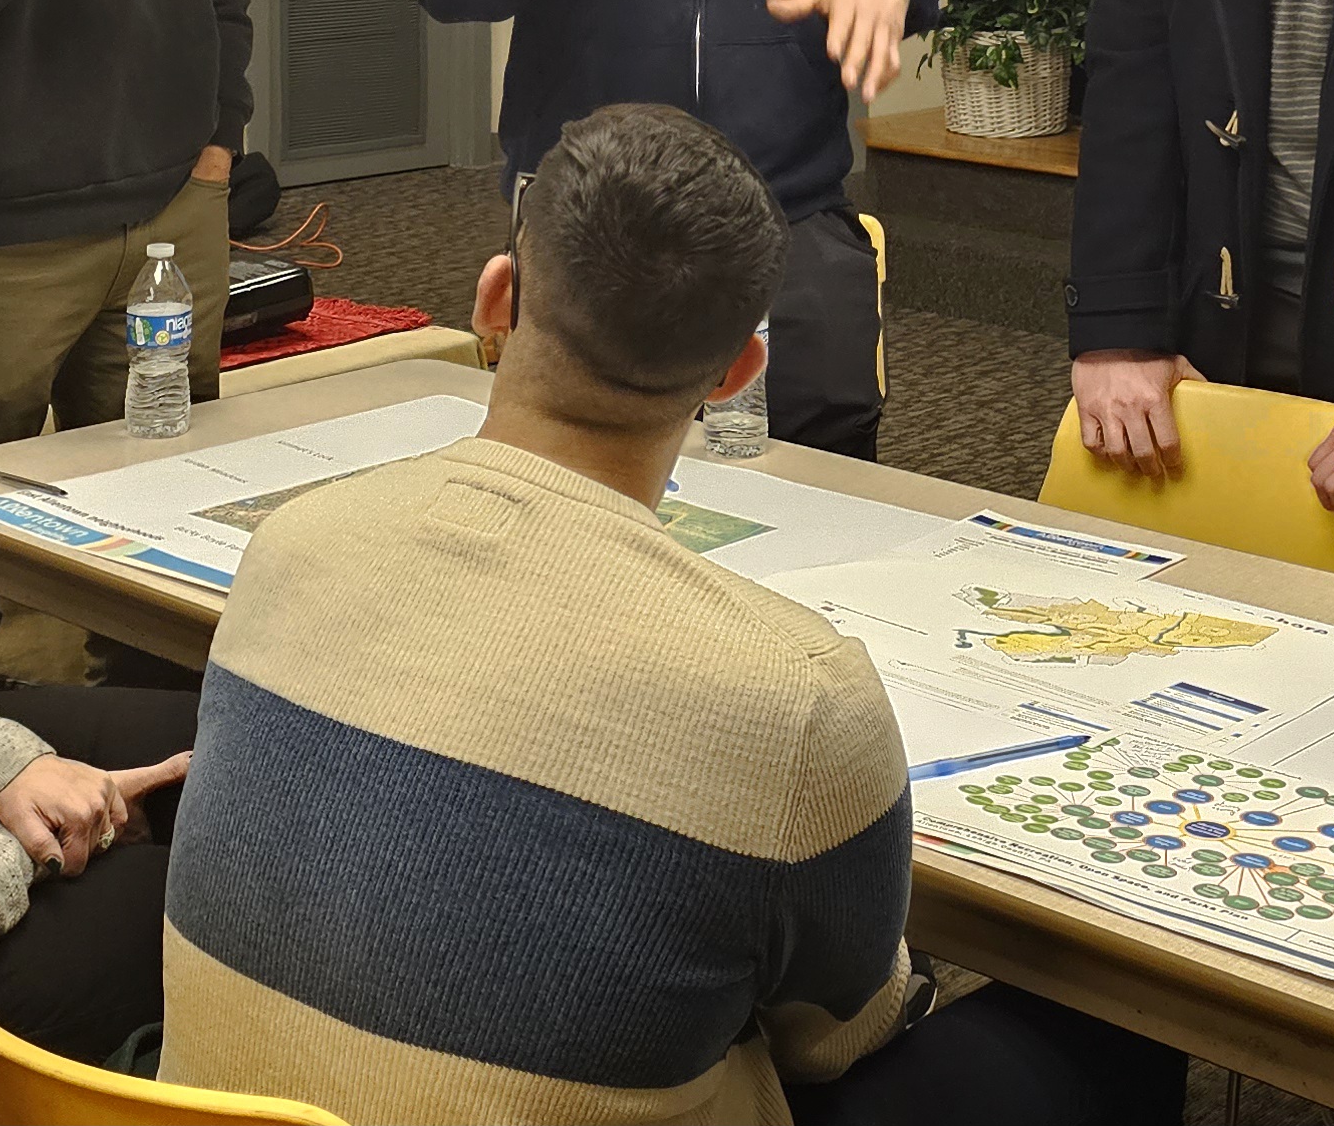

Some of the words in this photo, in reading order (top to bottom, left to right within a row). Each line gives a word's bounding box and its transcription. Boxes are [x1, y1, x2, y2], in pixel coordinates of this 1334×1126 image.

[923, 816, 1007, 845] Comprehensive
[1009, 841, 1075, 866] Recreation,
[1078, 864, 1109, 877] Open
[1111, 874, 1151, 891] Space,
[1154, 888, 1179, 900] and
[1181, 896, 1217, 912] Parks
[1219, 908, 1249, 921] Plan
